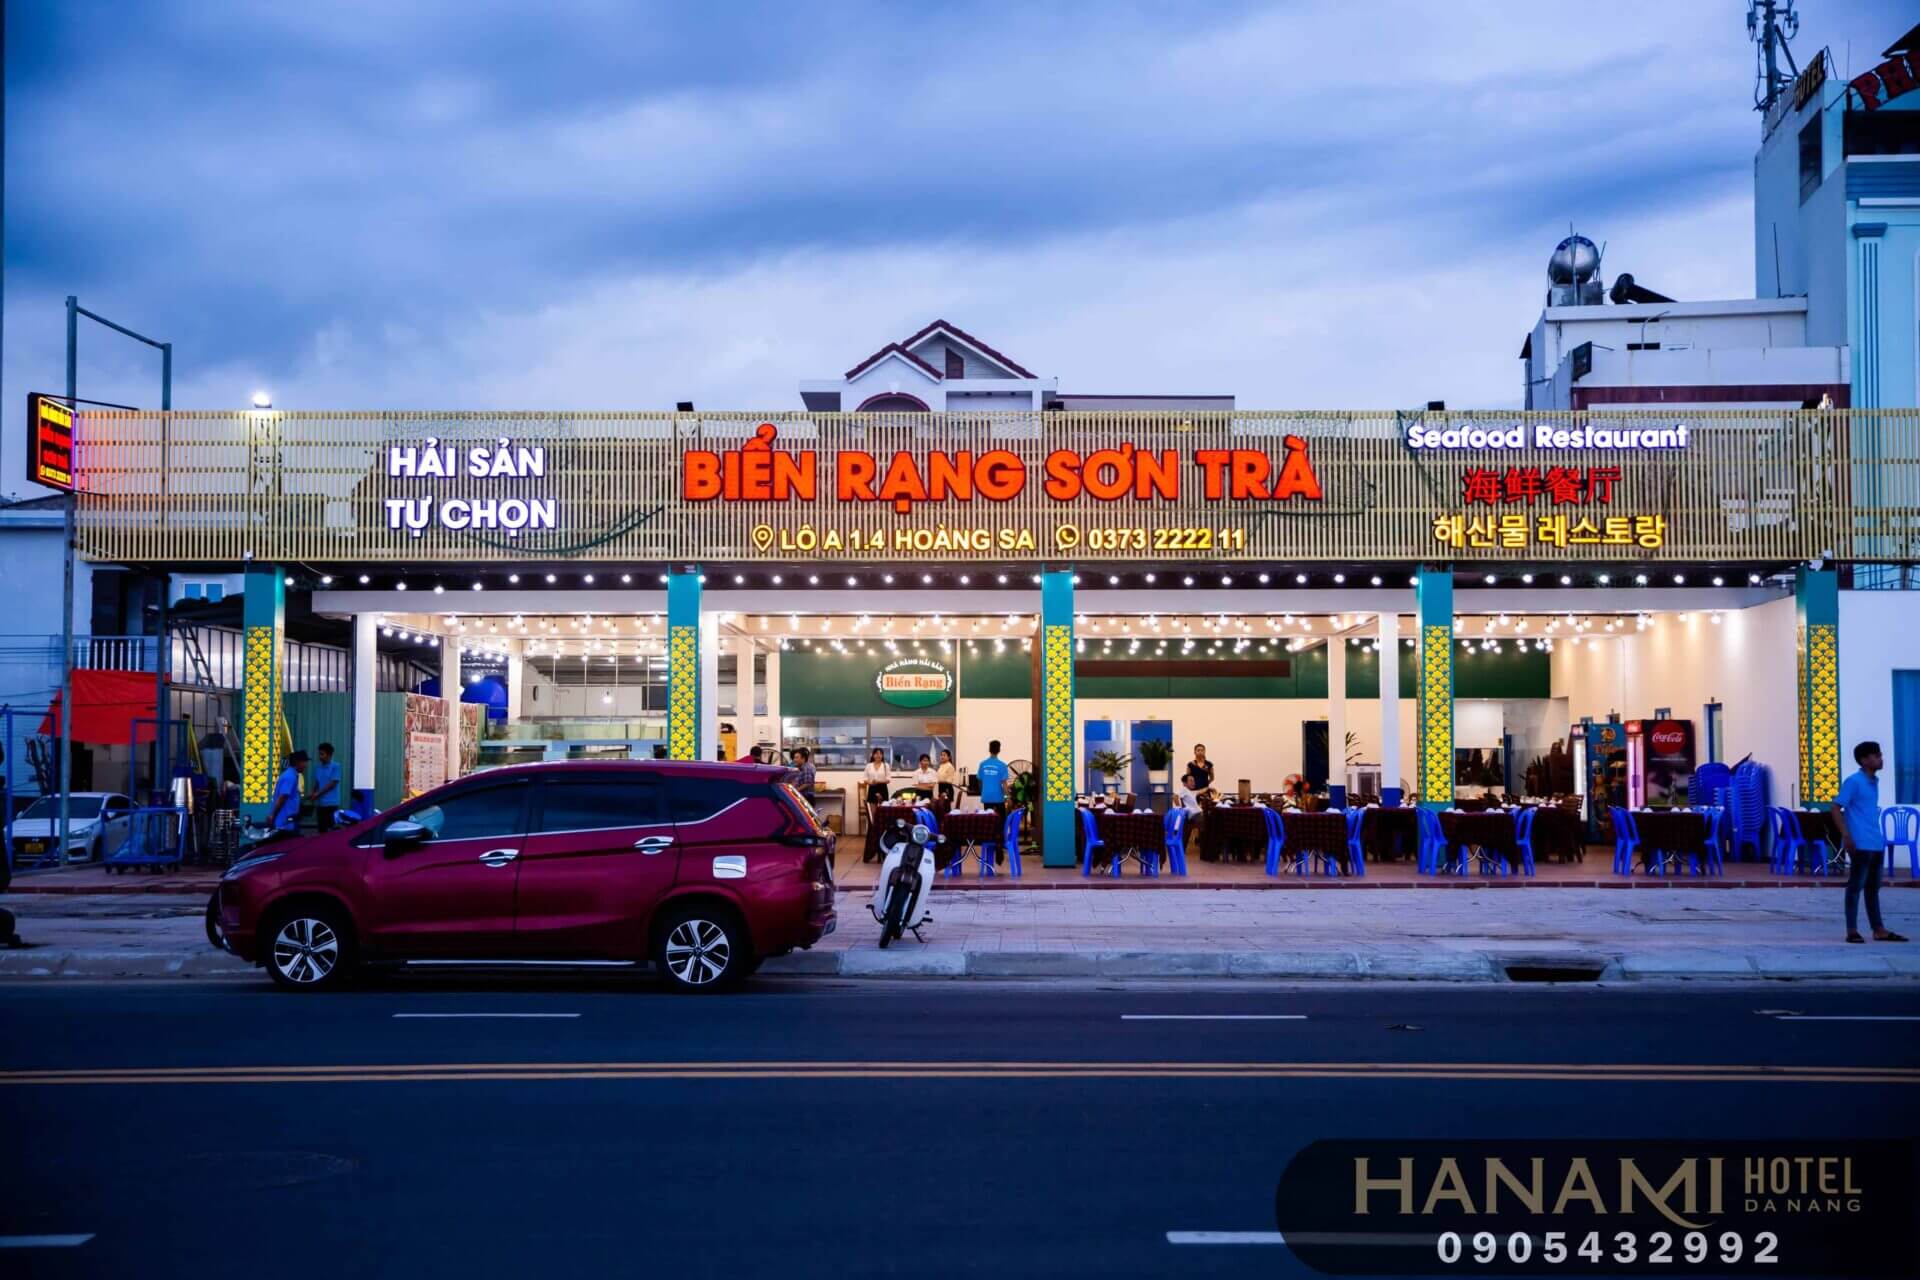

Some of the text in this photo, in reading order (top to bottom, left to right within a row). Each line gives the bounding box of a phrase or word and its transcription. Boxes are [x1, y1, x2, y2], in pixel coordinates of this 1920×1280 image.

[1407, 425, 1689, 449] Seafood Restaurant
[390, 437, 545, 477] HẢI SẢN
[683, 423, 1323, 515] BIỂN RẠNG SƠN TRÀ
[1462, 465, 1622, 505] 海鲜餐厅
[385, 495, 557, 538] TỰ CHỌN
[1433, 514, 1667, 548] 해산물 레스토랑
[780, 524, 1035, 550] LÔ A 1.4 HOÀNG SA
[1088, 528, 1244, 550] 0373 2222 11
